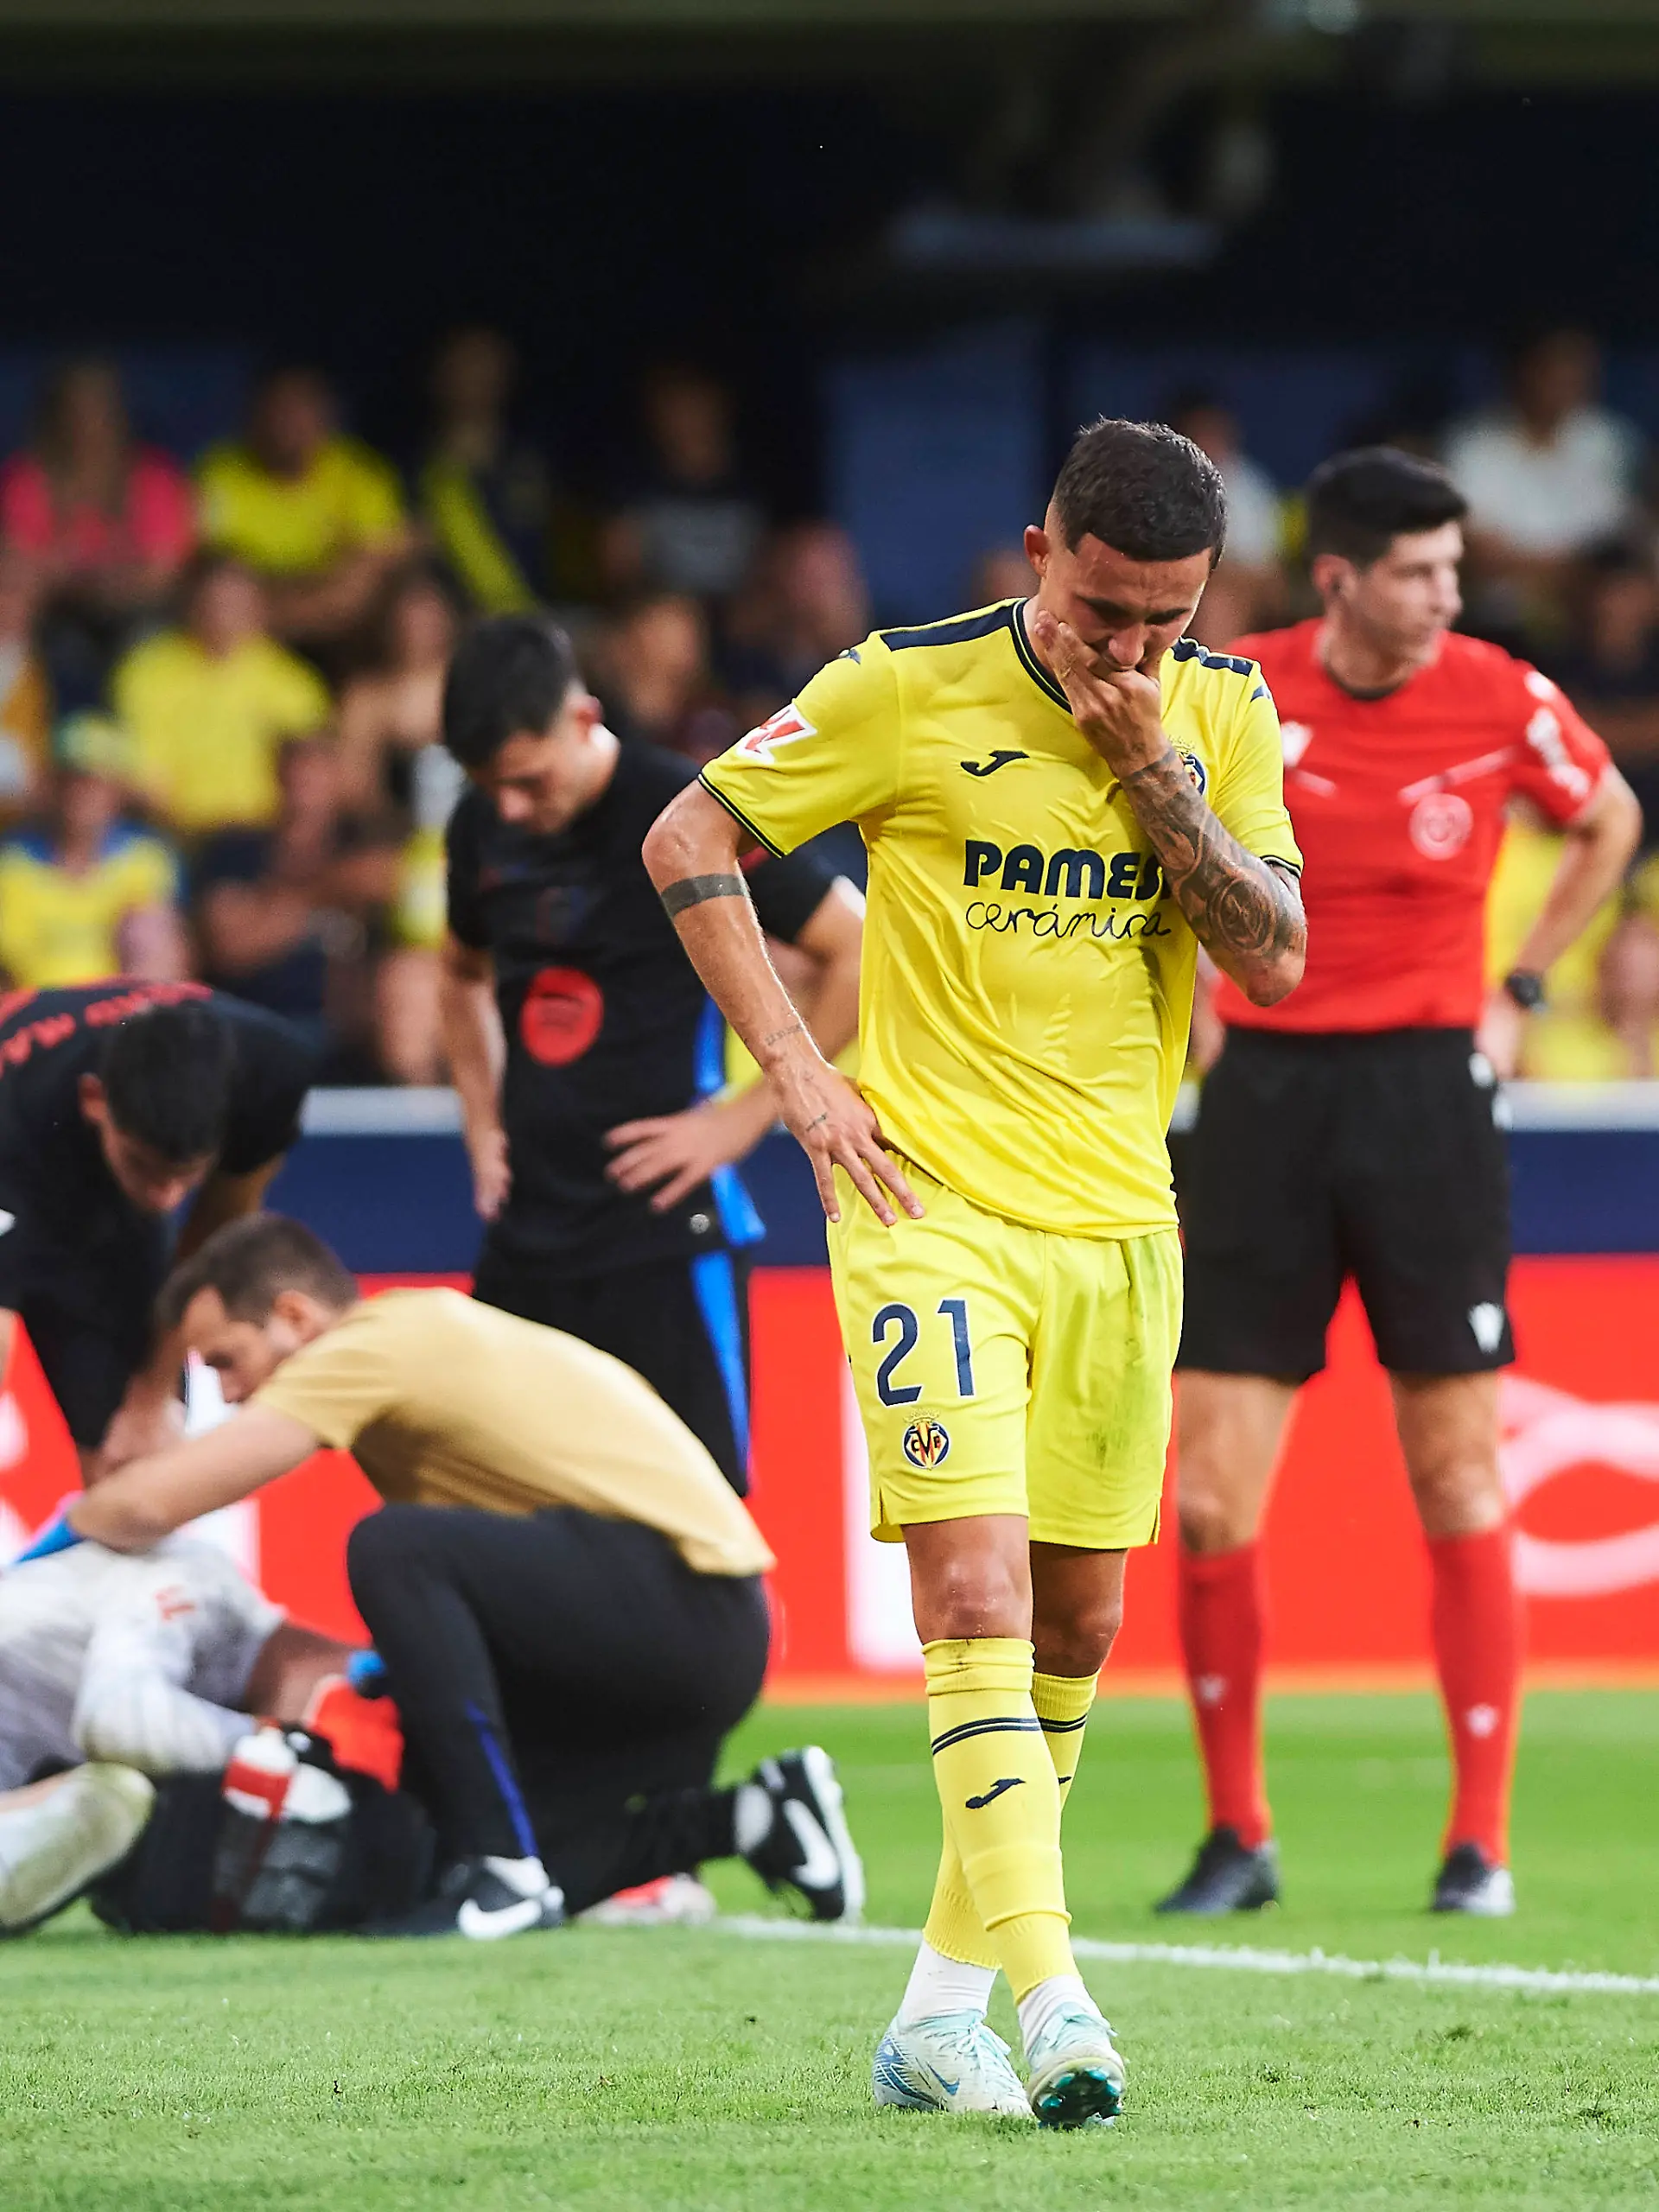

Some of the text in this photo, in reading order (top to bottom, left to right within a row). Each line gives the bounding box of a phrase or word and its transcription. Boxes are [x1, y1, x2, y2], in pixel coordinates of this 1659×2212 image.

[963, 839, 1171, 900] PAMES
[965, 901, 1172, 940] cerámica
[872, 1299, 976, 1407] 21
